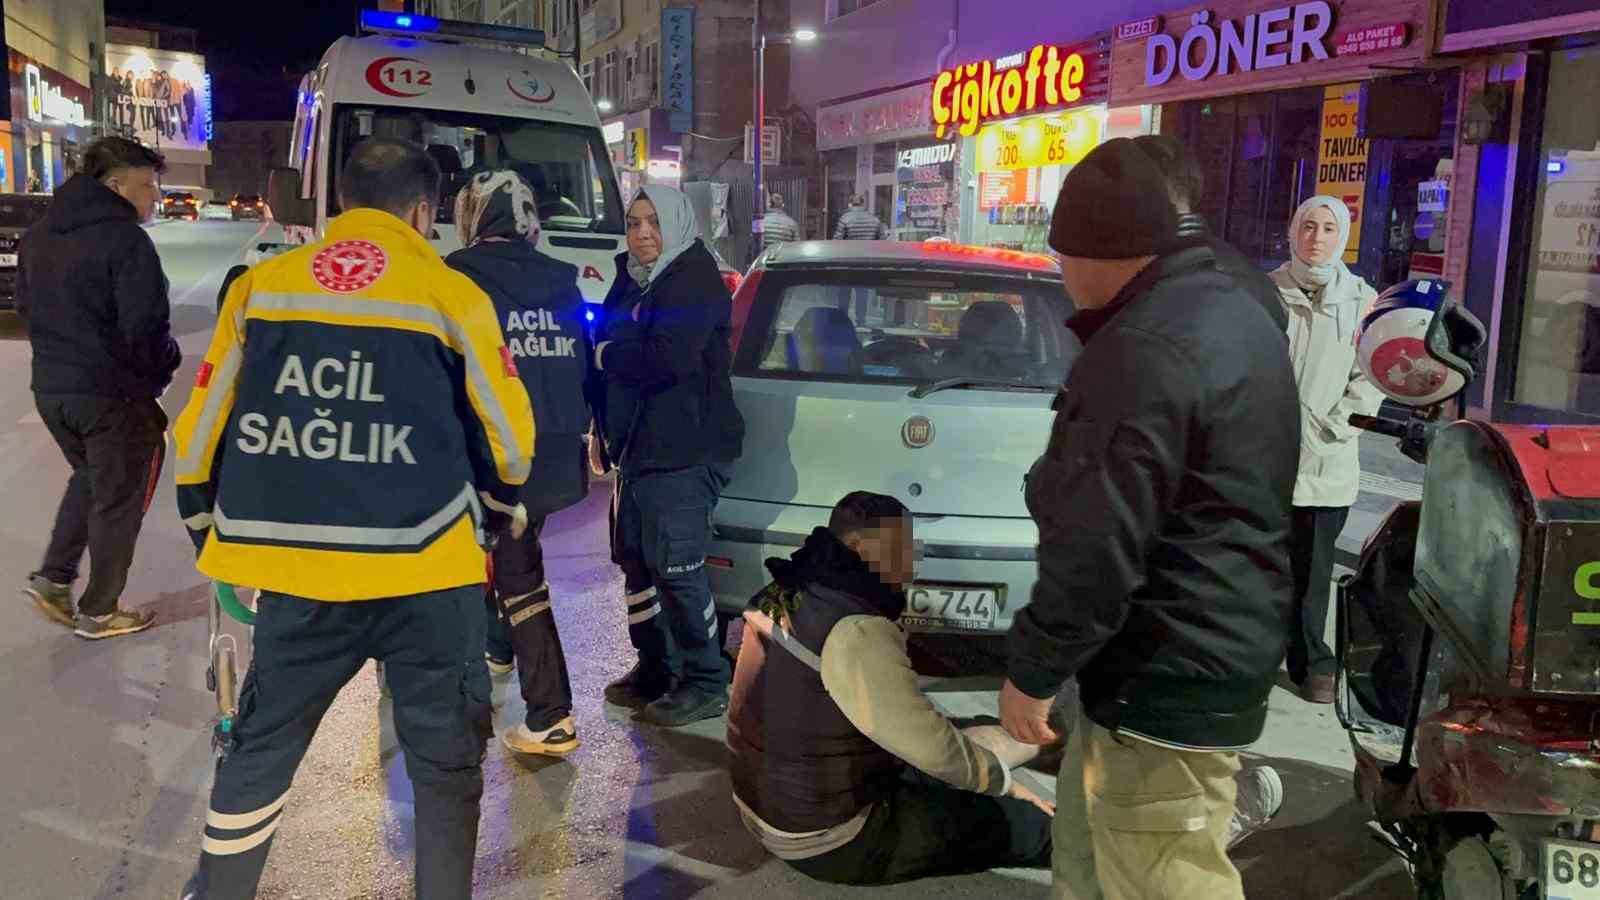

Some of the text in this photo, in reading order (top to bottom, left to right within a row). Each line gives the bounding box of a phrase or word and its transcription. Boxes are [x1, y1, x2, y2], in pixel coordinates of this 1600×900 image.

[1118, 19, 1156, 39] LEZZET
[1346, 26, 1396, 43] ALO PAKET
[1144, 1, 1331, 87] DÖNER
[383, 68, 432, 86] 112
[932, 44, 1085, 138] Çiğkofte
[1325, 112, 1348, 128] 100
[1047, 139, 1065, 161] 65
[1324, 137, 1366, 157] TAVUK
[1319, 162, 1366, 184] DÖNER
[506, 307, 560, 332] ACİL
[508, 333, 576, 358] AĞLIK
[274, 350, 385, 403] ACİL
[237, 405, 417, 465] SAĞLIK
[911, 425, 928, 442] FIAT
[940, 590, 989, 618] 744
[1552, 849, 1599, 889] 68
